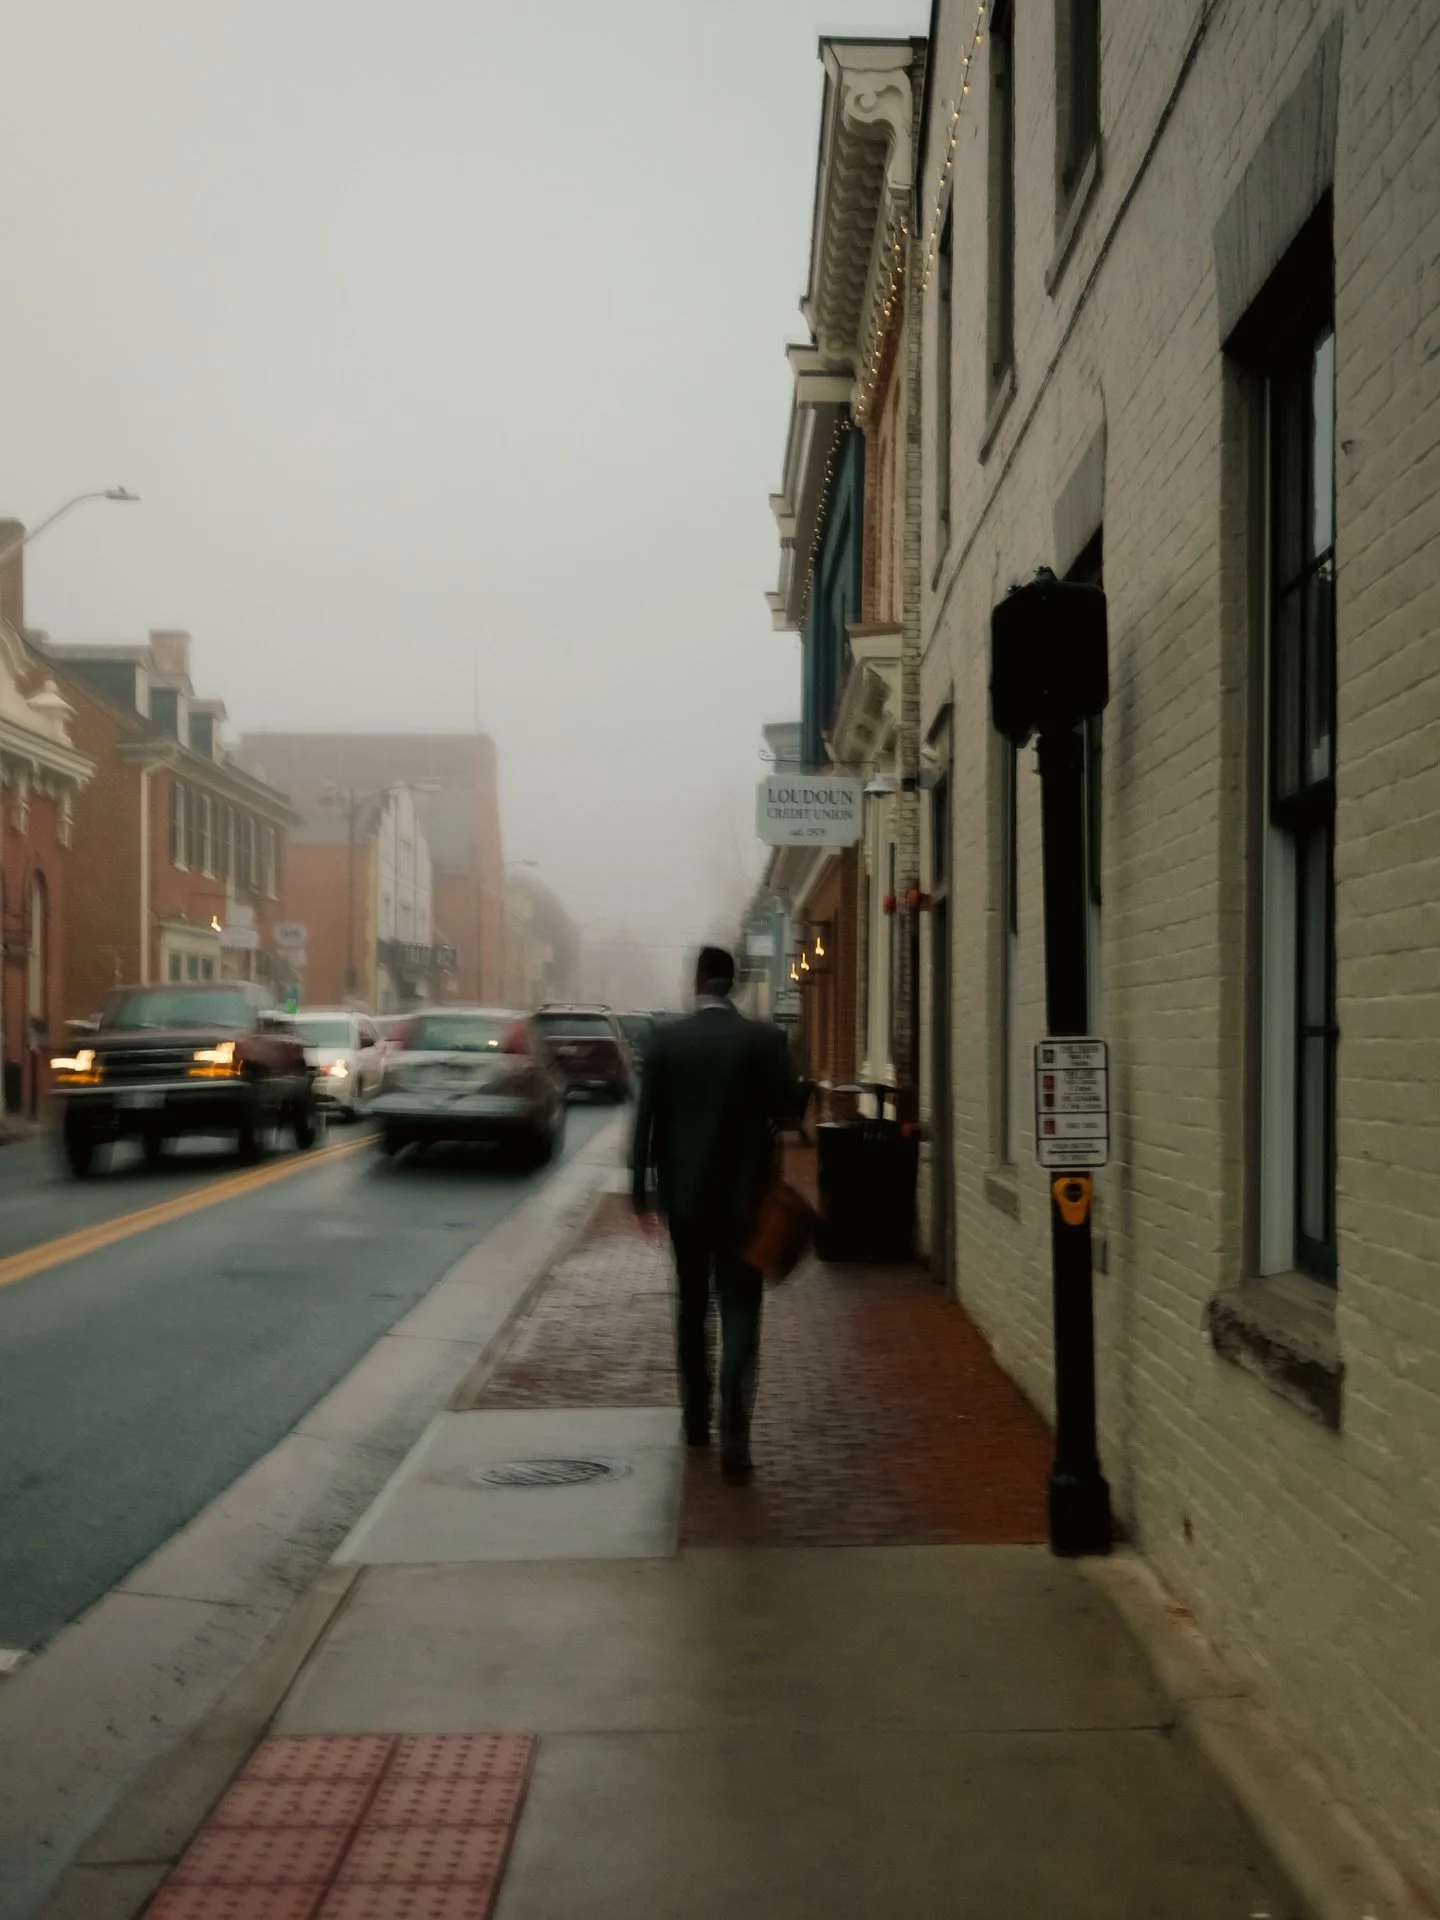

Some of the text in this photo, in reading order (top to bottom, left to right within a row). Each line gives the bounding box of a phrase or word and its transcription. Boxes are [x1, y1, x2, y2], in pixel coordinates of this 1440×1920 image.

[768, 788, 853, 805] LOUDOUN
[767, 807, 854, 820] CREDIT UNION
